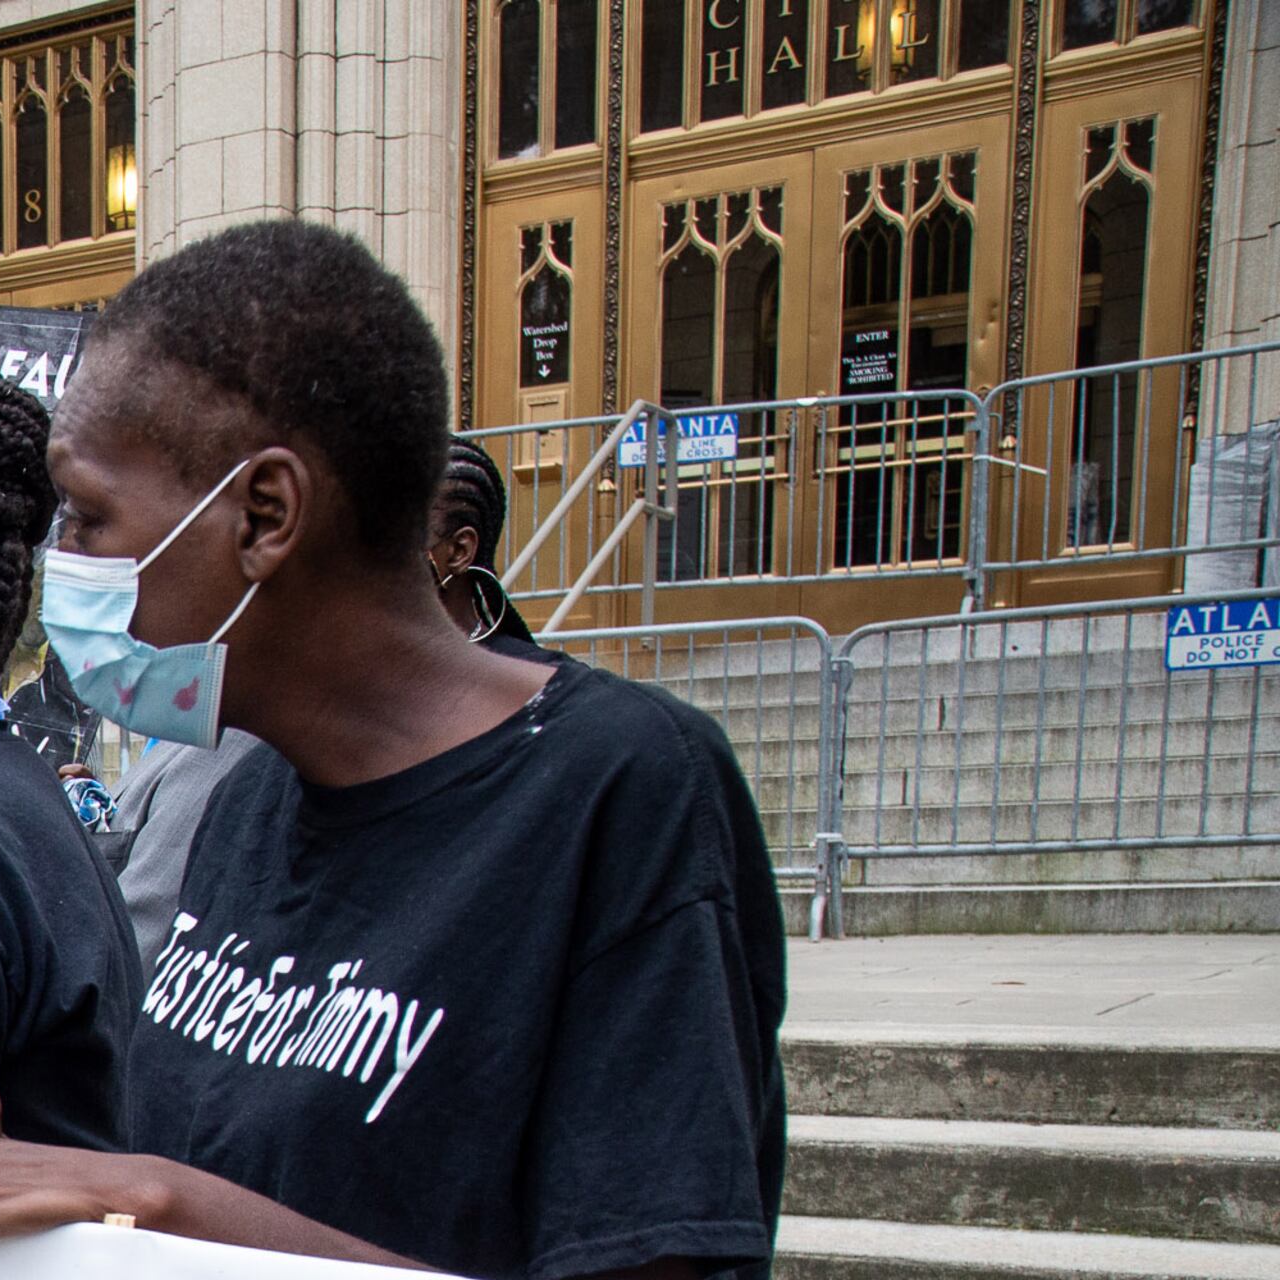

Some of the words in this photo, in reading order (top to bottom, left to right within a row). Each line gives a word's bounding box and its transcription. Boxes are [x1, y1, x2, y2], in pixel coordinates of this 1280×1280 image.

[523, 321, 568, 336] Watershed
[856, 331, 889, 343] ENTER
[533, 338, 558, 349] Drop
[535, 351, 554, 361] Box
[849, 366, 888, 377] SMOKING
[622, 415, 734, 442] ATANTA
[691, 439, 717, 449] LINE
[686, 447, 724, 458] CROSS
[1172, 603, 1280, 635] ATLA
[1200, 634, 1265, 649] POLICE
[1186, 651, 1211, 663] DO
[1224, 648, 1260, 660] NOT
